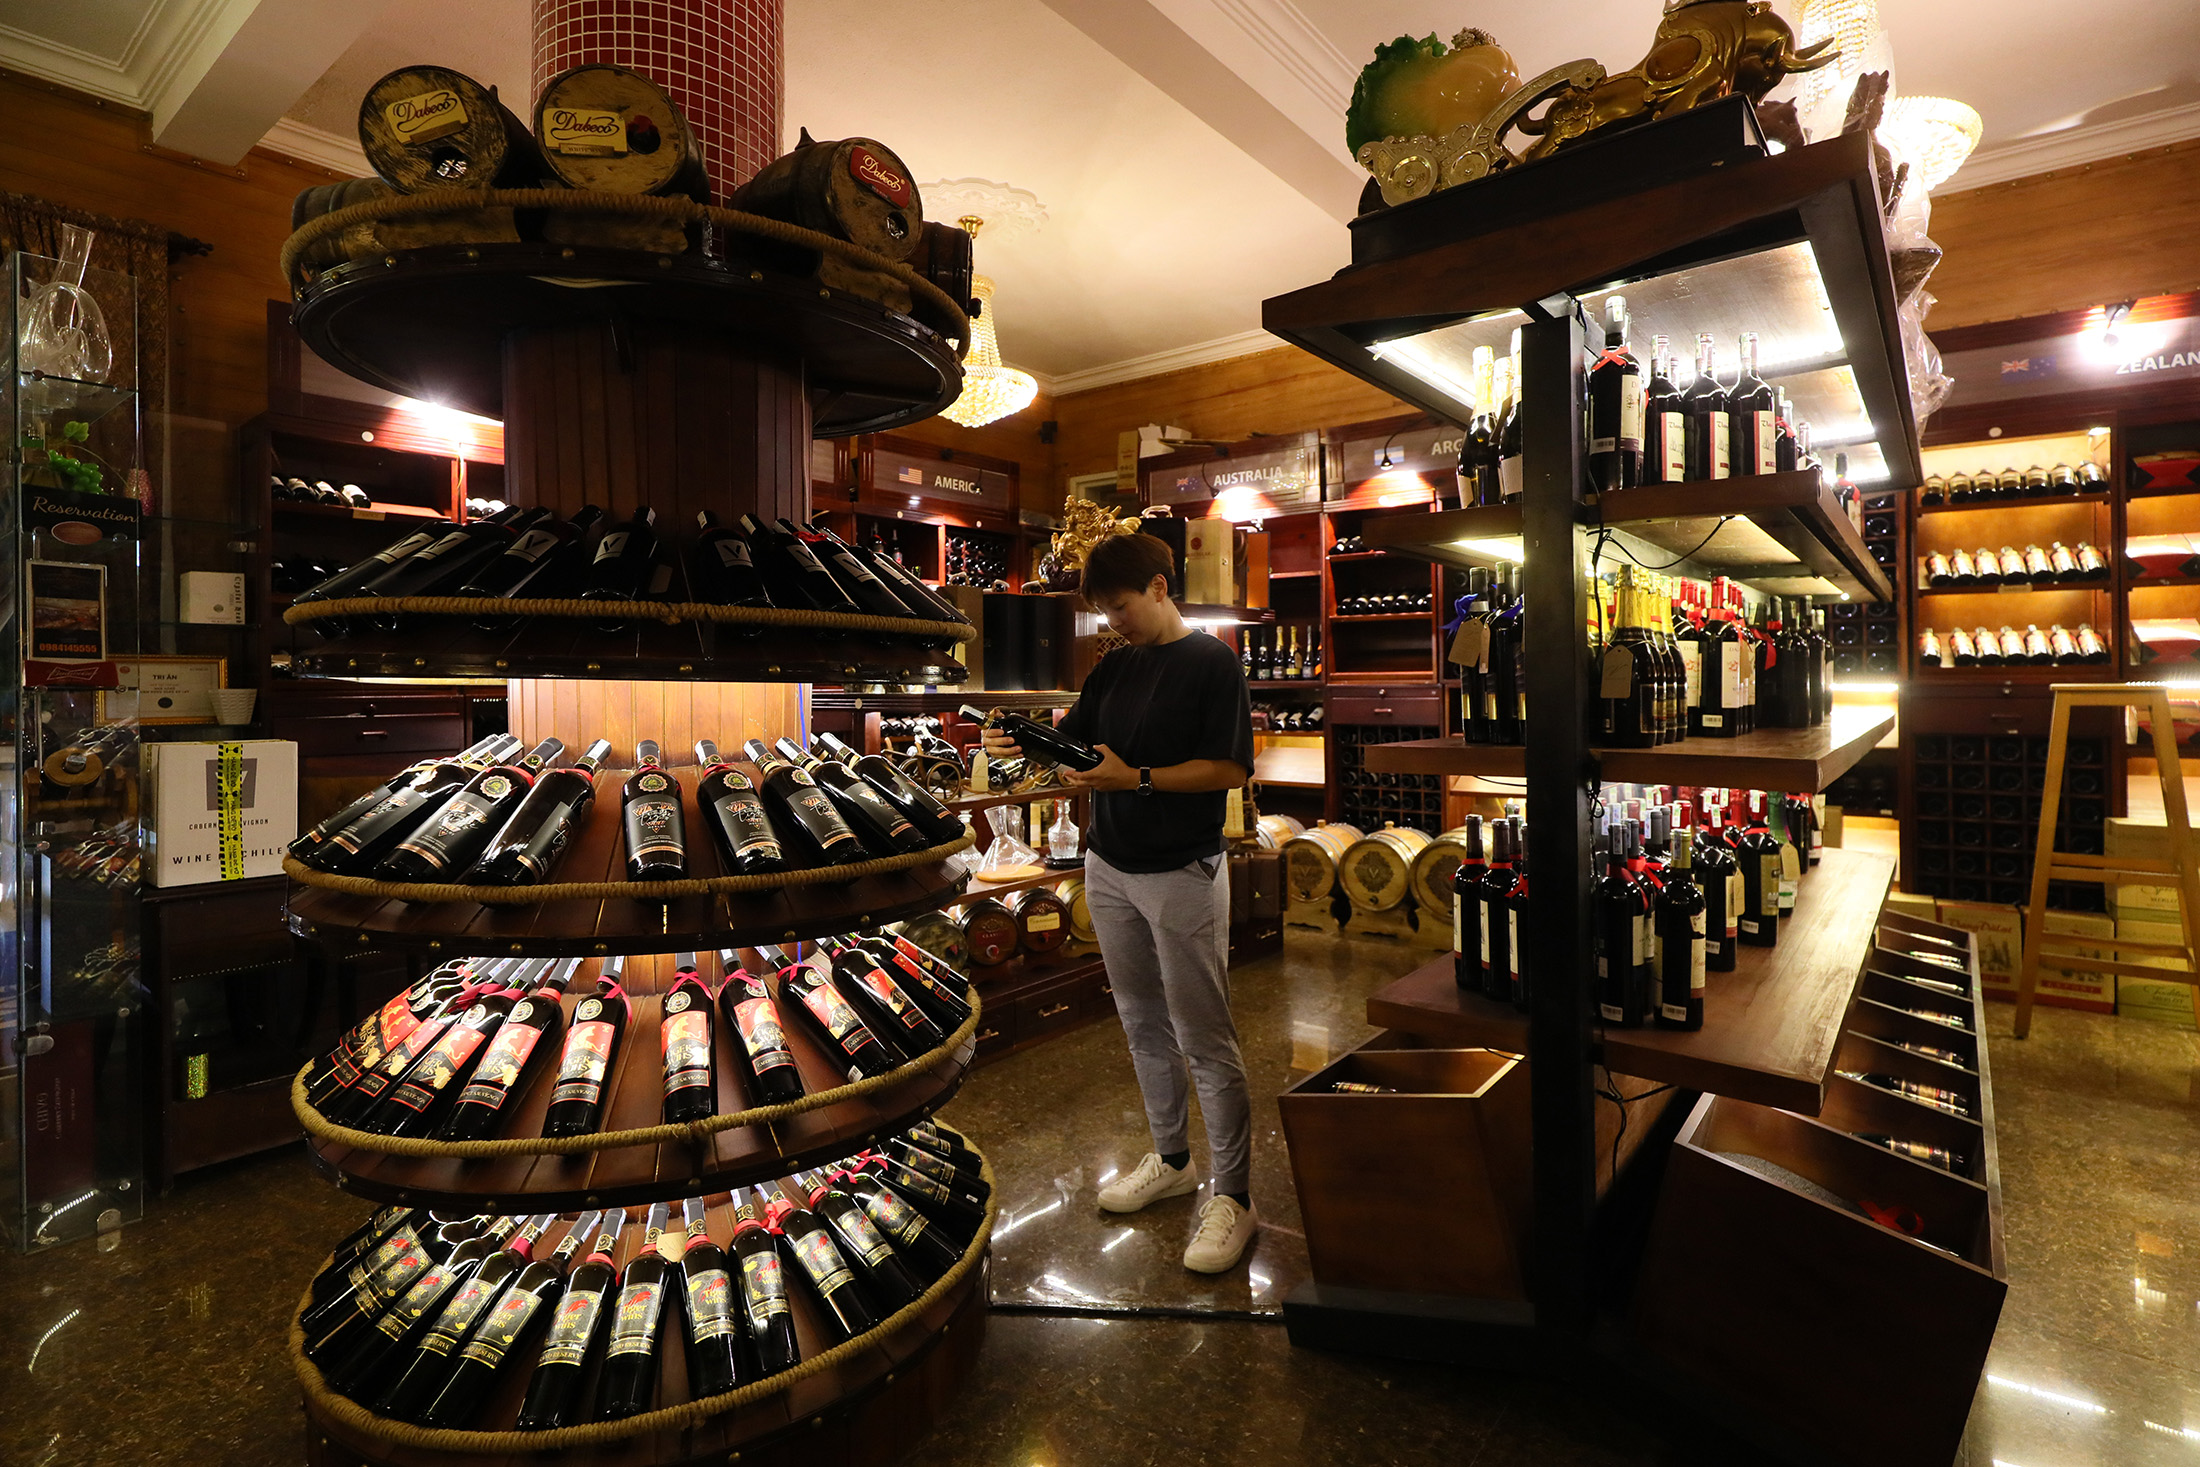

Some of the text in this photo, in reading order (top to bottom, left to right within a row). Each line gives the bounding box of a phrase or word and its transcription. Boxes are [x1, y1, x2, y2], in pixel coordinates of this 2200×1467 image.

[393, 92, 457, 131] Dabeco
[552, 111, 620, 138] Dabeco
[860, 155, 902, 192] Dabeco
[934, 475, 982, 495] AMERIC
[1213, 466, 1283, 487] AUSTRALIA
[32, 496, 138, 523] Reservation
[173, 853, 212, 865] WINE
